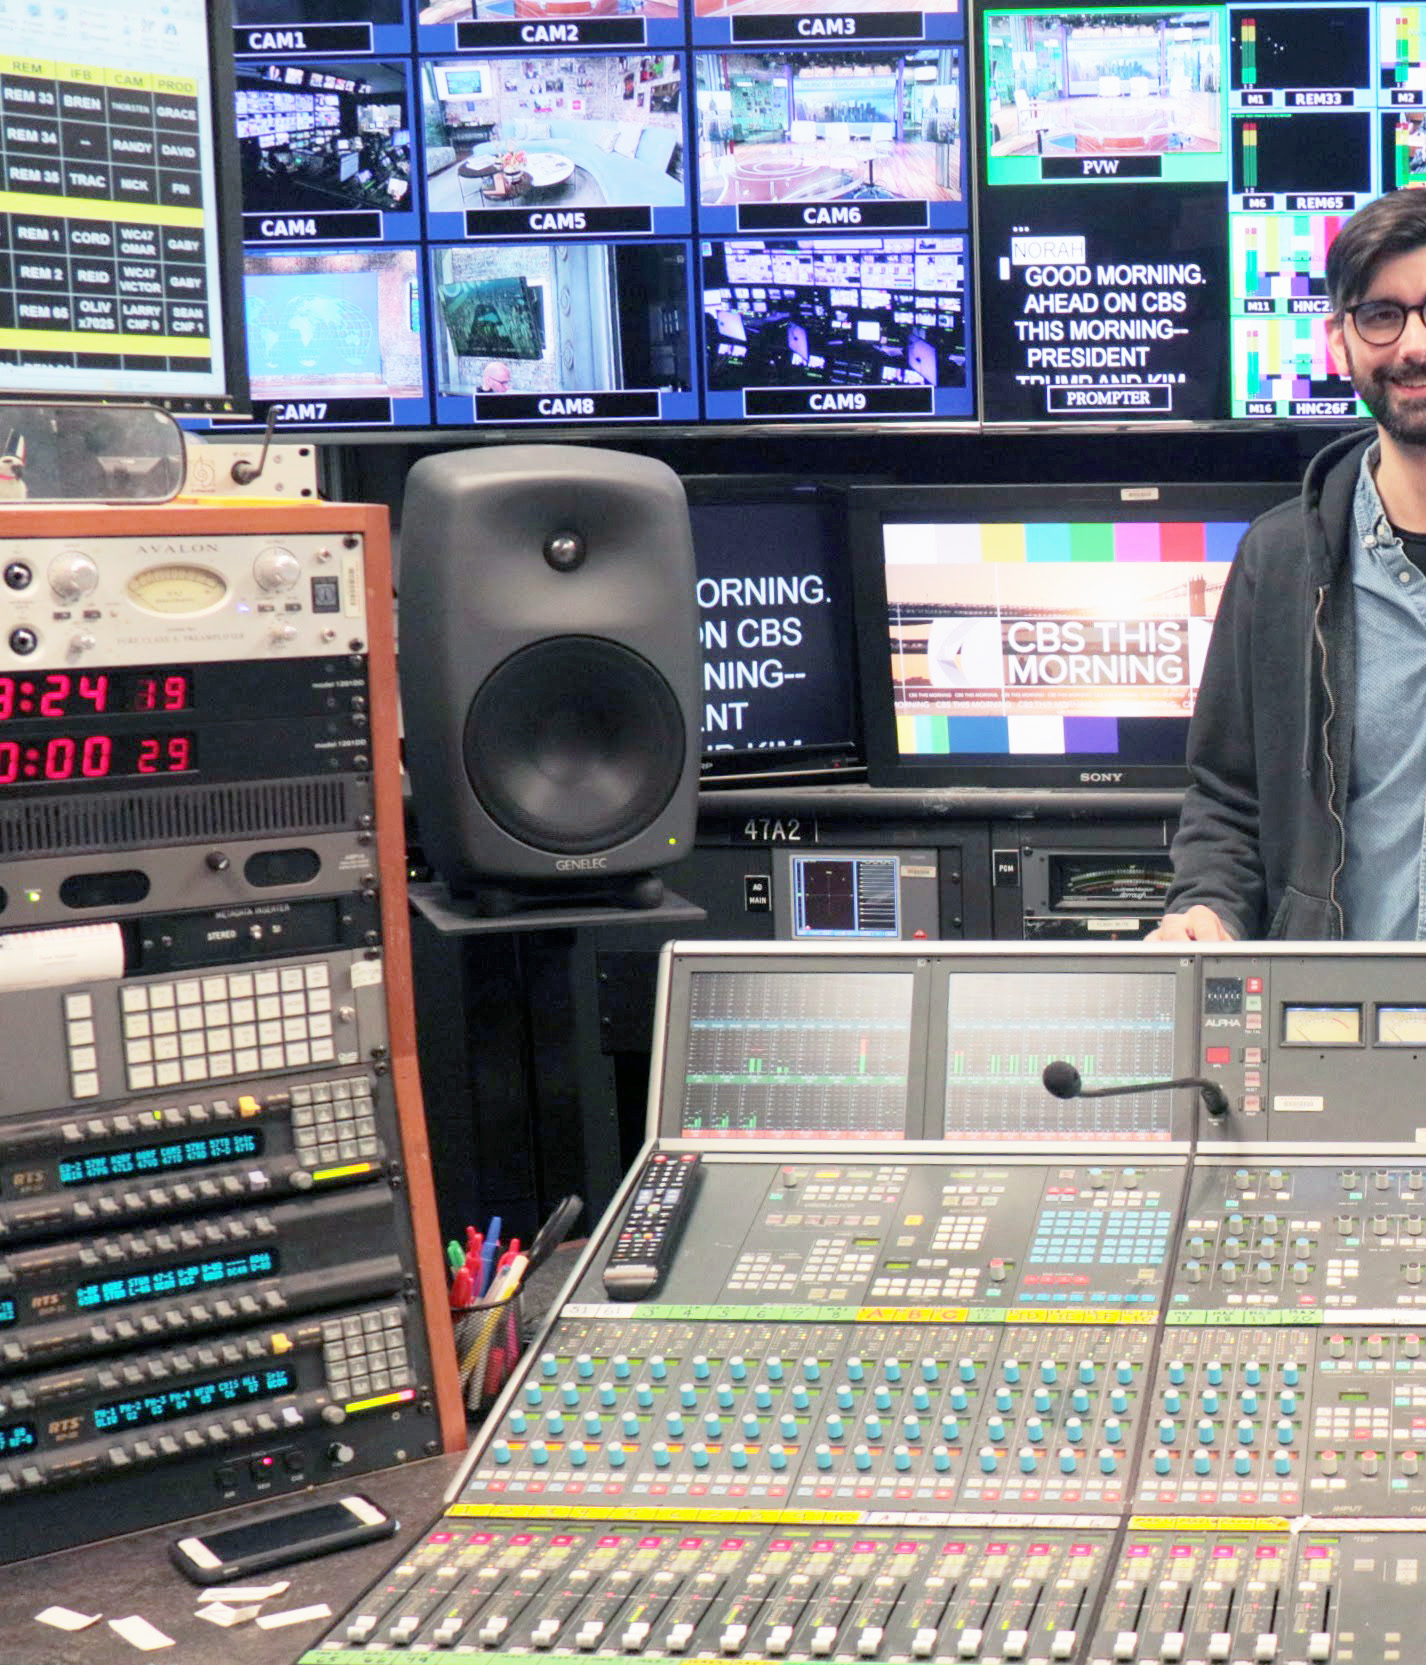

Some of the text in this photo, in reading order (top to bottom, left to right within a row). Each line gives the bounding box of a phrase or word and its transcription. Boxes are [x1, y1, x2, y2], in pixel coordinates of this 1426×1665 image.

[521, 24, 579, 44] CAM2
[797, 18, 856, 36] CAM3
[248, 31, 307, 50] CAM1
[13, 61, 42, 74] REM
[4, 87, 55, 105] REM 33
[64, 94, 101, 110] BREN
[1295, 92, 1342, 105] REM33
[157, 106, 197, 121] GRACE
[7, 127, 57, 144] REM 34
[113, 139, 152, 153] RANDY
[162, 145, 196, 158] DAVID
[1082, 160, 1119, 175] PVW
[9, 167, 60, 184] REM 35
[69, 173, 106, 188] TRAC
[1297, 197, 1344, 209] REM65
[529, 213, 587, 231] CAM5
[802, 207, 861, 225] CAM6
[17, 226, 59, 242] REM 1
[261, 219, 317, 237] CAM4
[72, 231, 110, 245] CORD
[1014, 242, 1084, 259] NORAH
[20, 265, 63, 281] REM 2
[77, 269, 110, 283] REID
[1025, 264, 1207, 287] GOOD MORNING.
[1024, 292, 1186, 314] AHEAD ON CBS
[19, 304, 51, 318] REM
[1014, 319, 1189, 341] THIS MORNING--
[1027, 347, 1150, 368] PRESIDENT
[809, 393, 866, 411] CAM9
[1066, 391, 1150, 405] PROMPTER
[274, 403, 327, 421] CAM7
[538, 398, 595, 416] CAM8
[1295, 402, 1348, 415] HNC26F
[136, 544, 219, 554] AVALON
[737, 616, 802, 647] CBS
[1008, 620, 1182, 654] CBS THIS
[1007, 654, 1183, 685] MORNING
[138, 737, 190, 773] 29
[1080, 772, 1123, 782] SONY
[744, 819, 801, 841] 47A2
[555, 857, 607, 872] GENELEC
[999, 864, 1014, 873] PGM
[749, 896, 766, 905] MAIN
[207, 929, 237, 941] STEREO
[1203, 1018, 1240, 1028] ALPHA
[31, 1294, 60, 1308] RTS
[866, 1310, 884, 1320] A
[907, 1310, 922, 1320] B
[942, 1310, 957, 1320] C
[48, 1418, 80, 1433] RTS
[1332, 1505, 1363, 1513] INPUT
